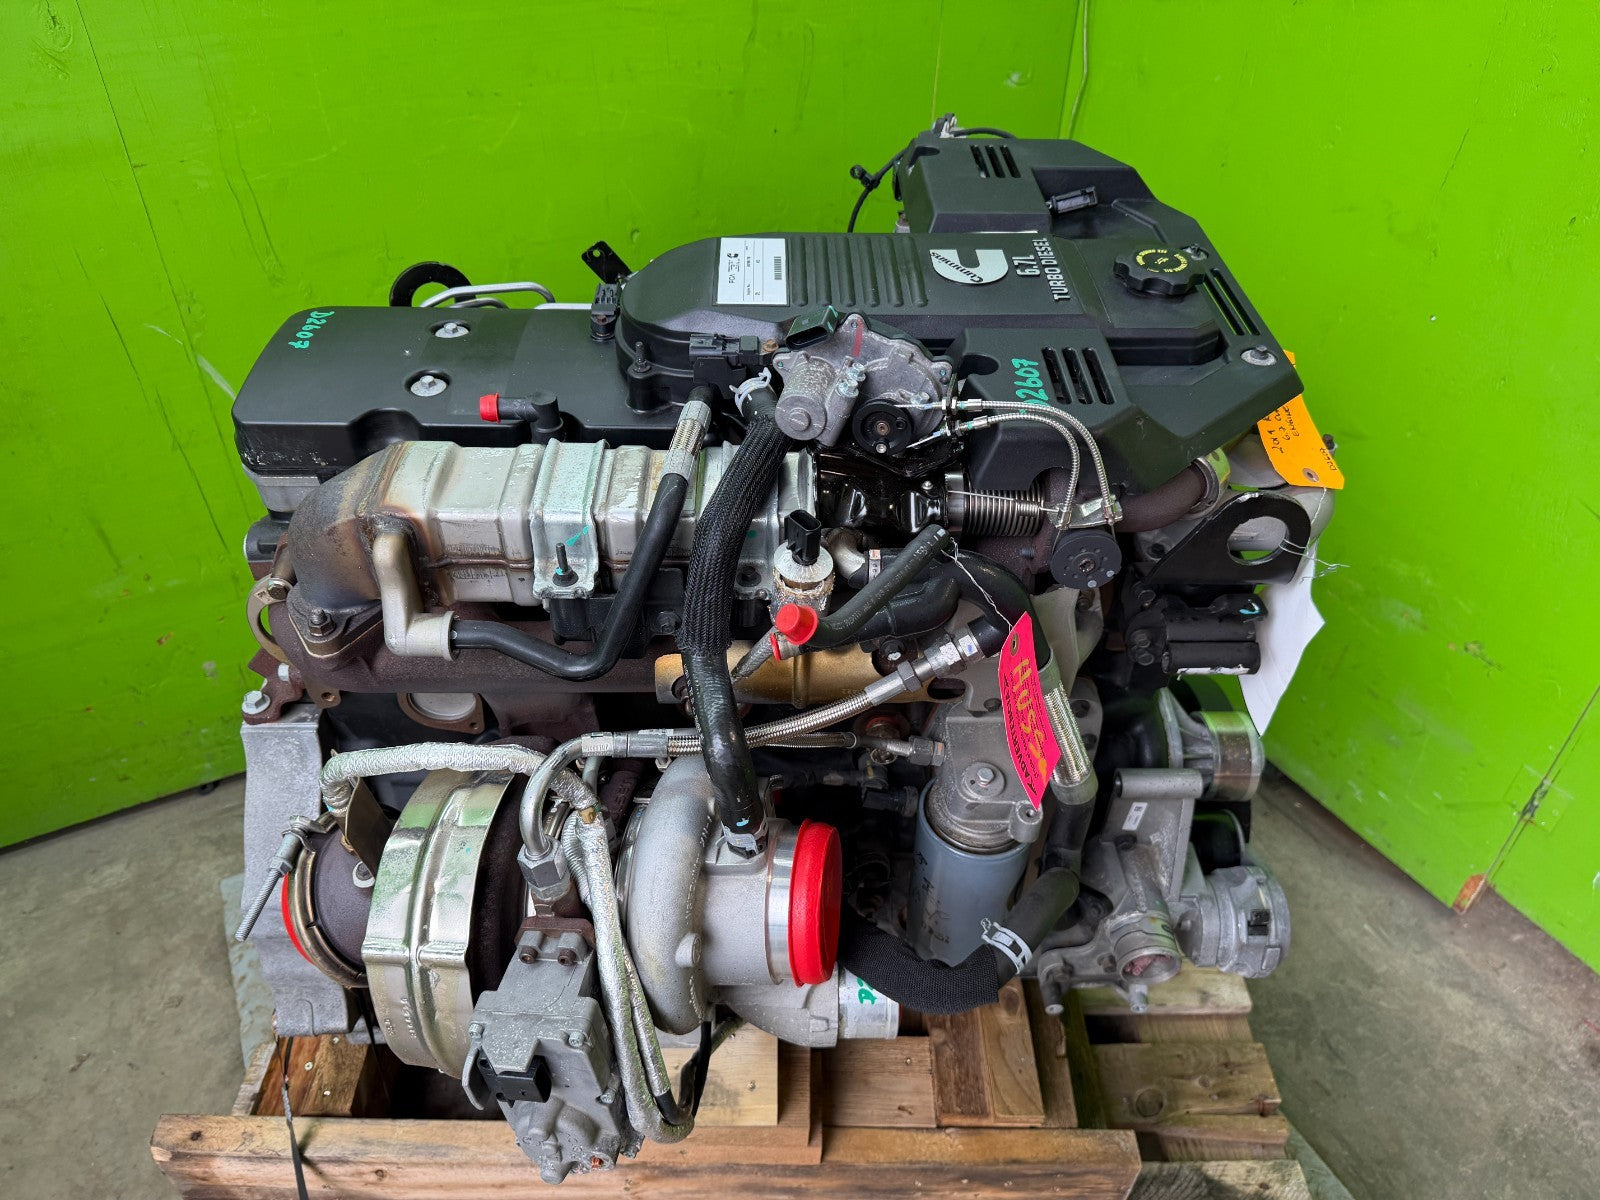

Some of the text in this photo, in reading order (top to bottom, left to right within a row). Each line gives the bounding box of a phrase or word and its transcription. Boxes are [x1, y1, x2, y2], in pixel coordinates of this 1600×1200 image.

[930, 251, 984, 283] Cummins
[1011, 254, 1041, 277] 6.7L
[1031, 237, 1071, 302] TURBO DIESEL
